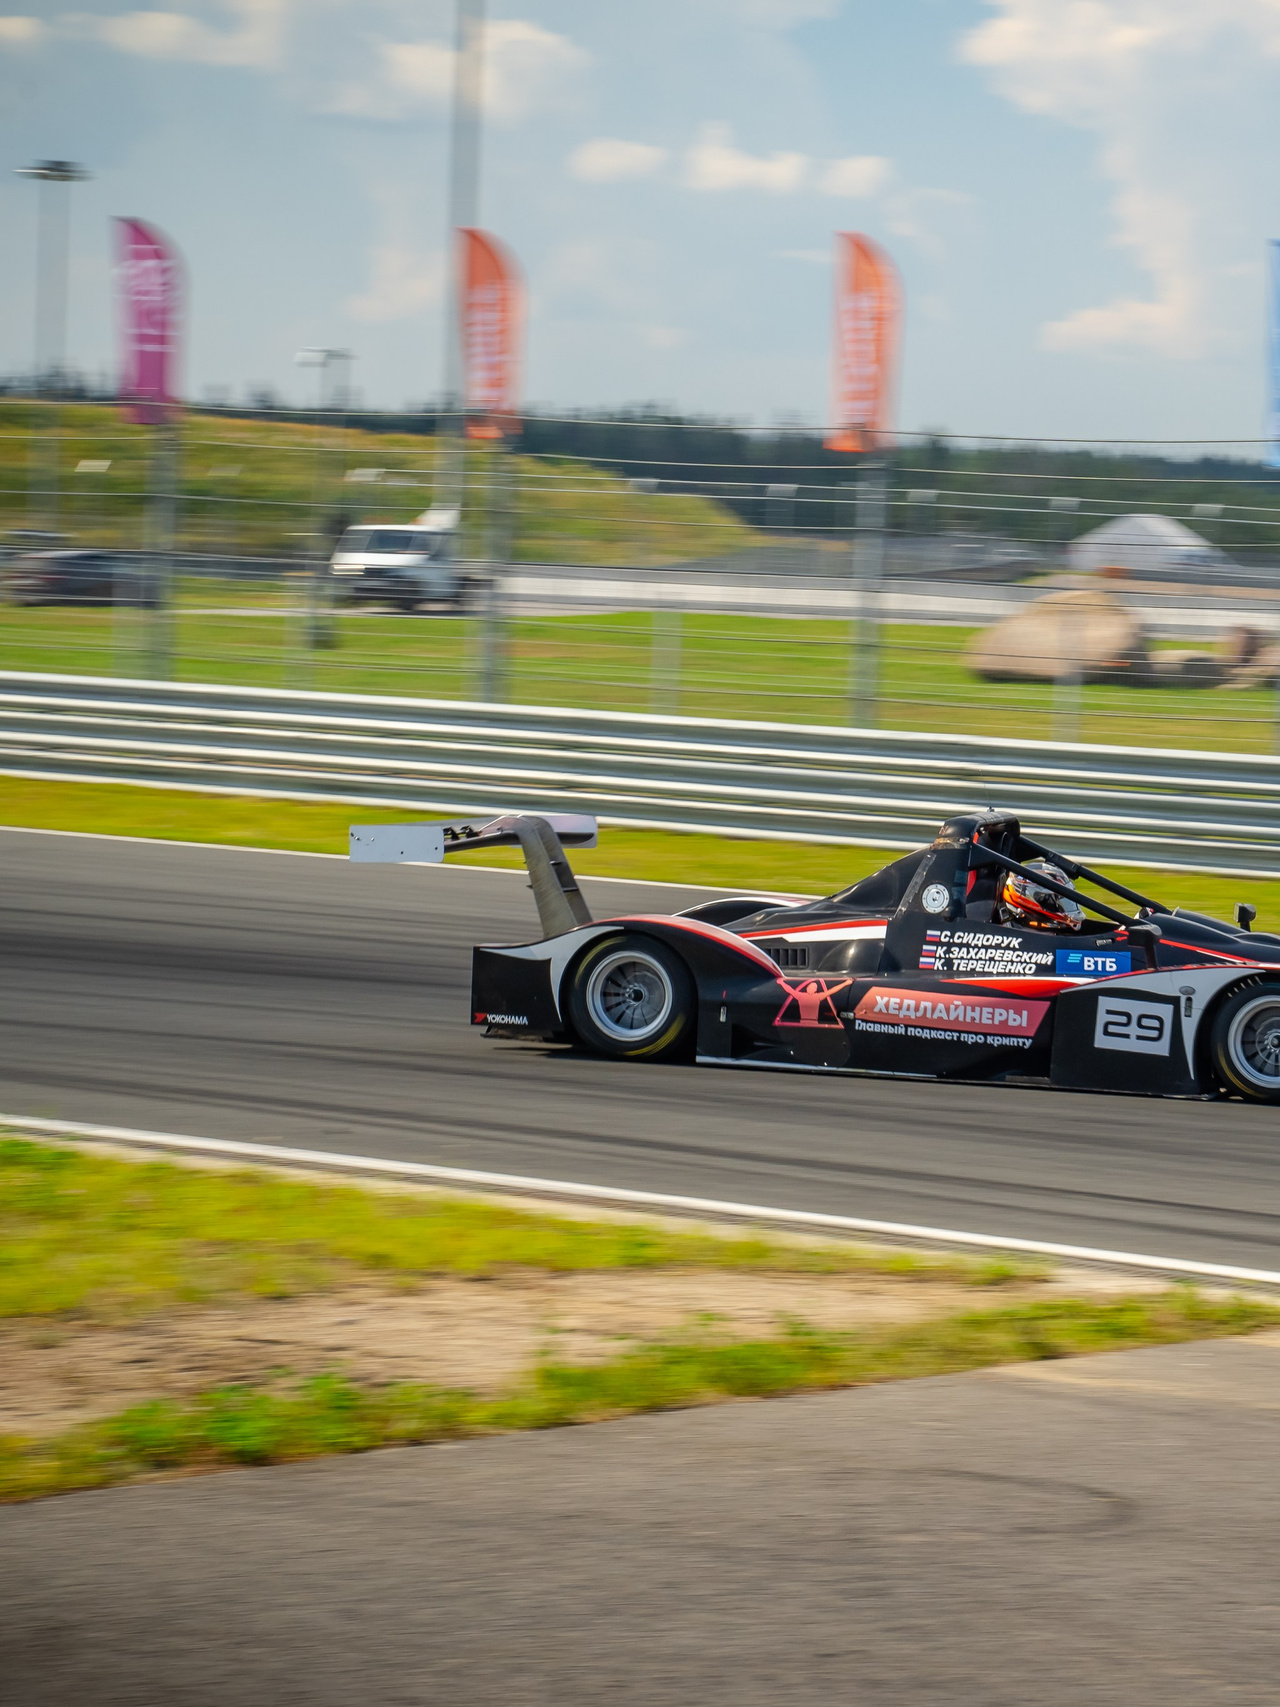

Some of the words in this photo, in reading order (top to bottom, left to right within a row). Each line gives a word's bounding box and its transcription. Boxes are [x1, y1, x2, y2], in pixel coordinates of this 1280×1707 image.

[940, 930, 1023, 949] С.СИДОРУК
[935, 946, 1054, 966] К.ЗАХАРЕВСКИЙ
[1083, 956, 1117, 972] ВТБ
[952, 959, 1037, 974] ТЕРЕЩЕНКО
[486, 1013, 529, 1025] YOKOHAMA
[873, 995, 1028, 1027] ХЕДЛАЙНЕРЫ
[855, 1020, 906, 1036] Главный
[907, 1026, 960, 1041] подкаст
[960, 1032, 985, 1044] про
[986, 1035, 1033, 1049] крипту
[1102, 1009, 1164, 1042] 29
